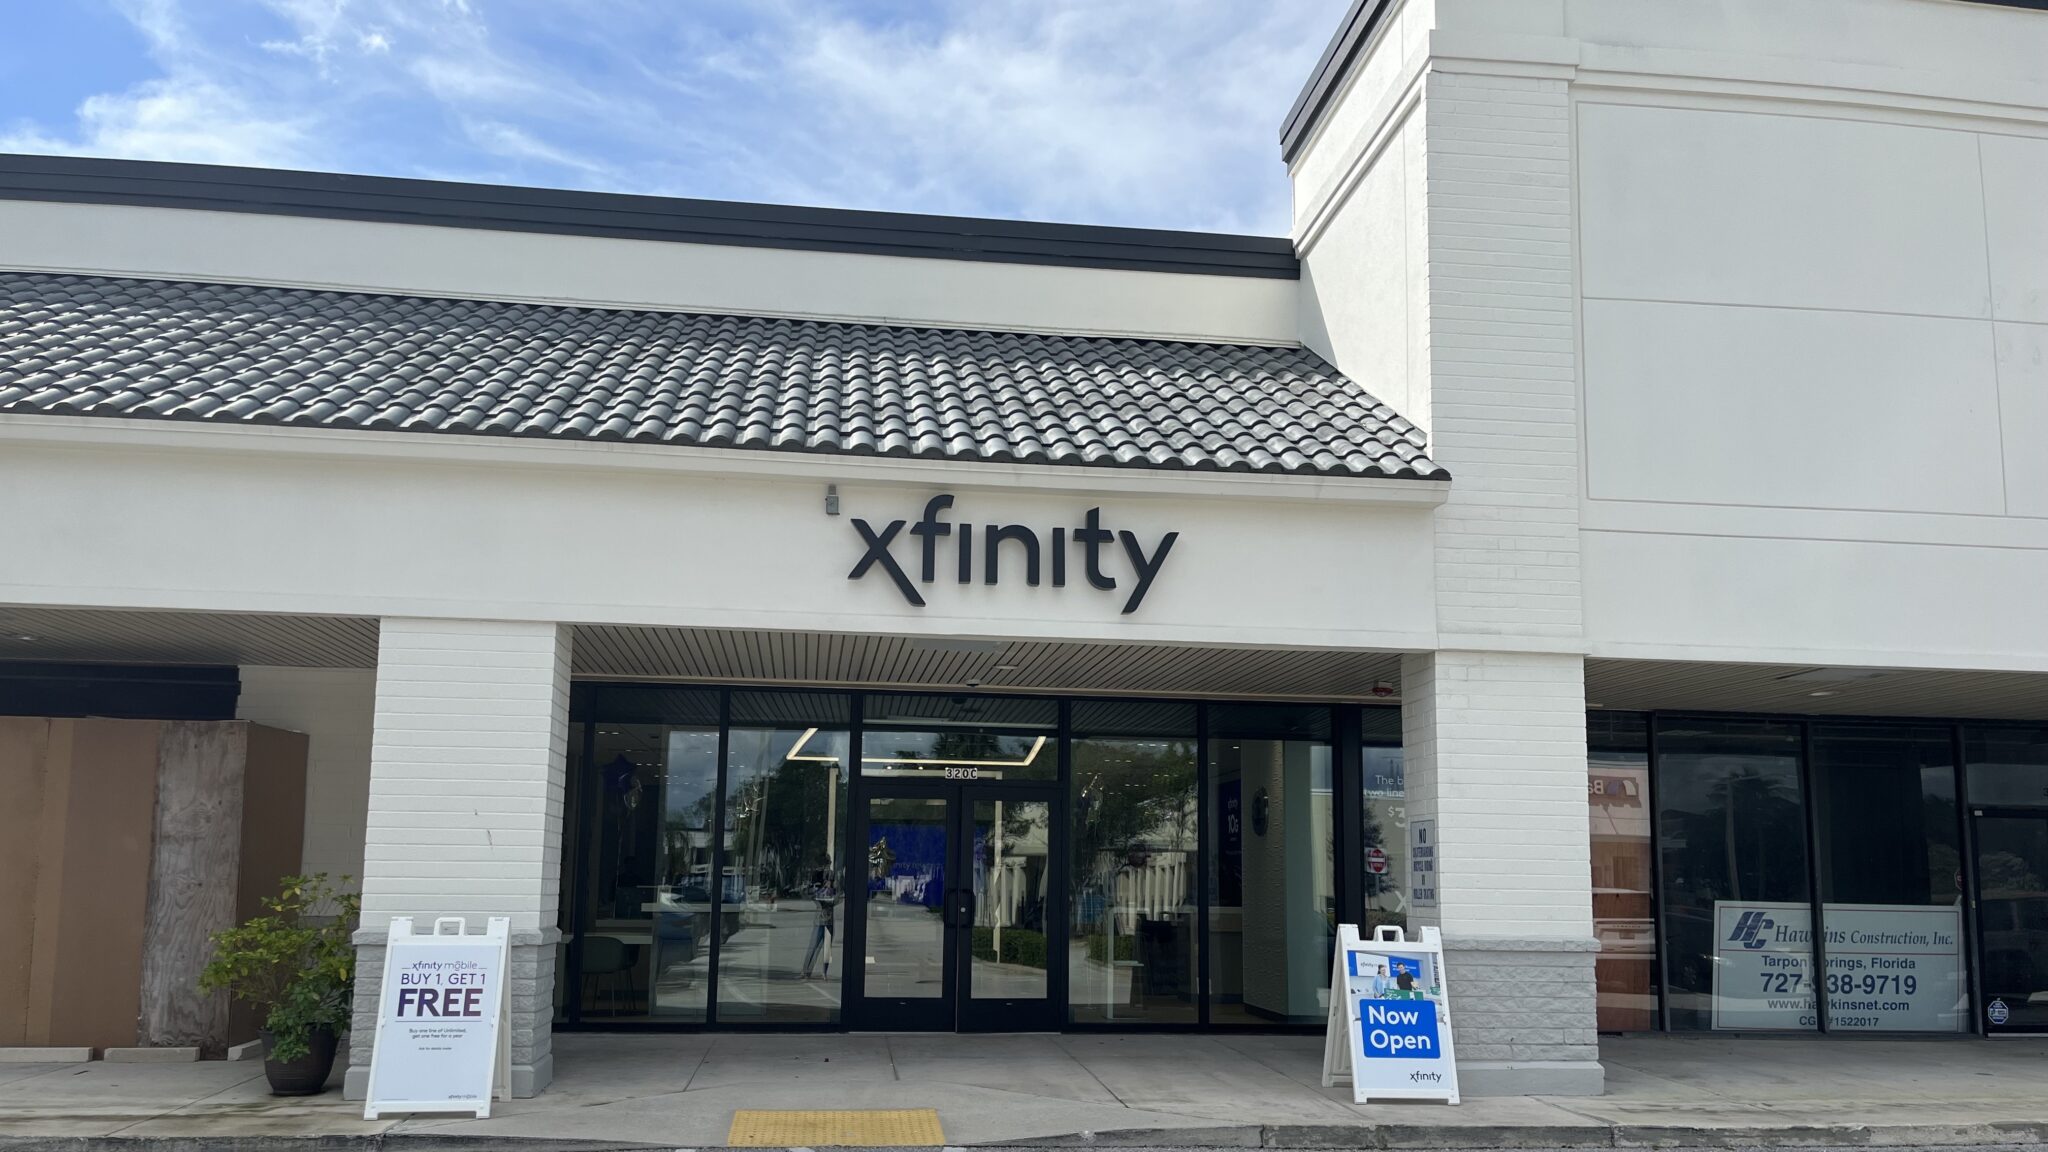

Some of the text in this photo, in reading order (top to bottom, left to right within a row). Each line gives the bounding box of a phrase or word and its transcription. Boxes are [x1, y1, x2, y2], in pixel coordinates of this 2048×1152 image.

[848, 494, 1180, 615] xfinity
[946, 768, 977, 779] 320C
[1376, 775, 1395, 785] The
[1418, 828, 1427, 844] NO
[1775, 925, 1953, 947] Hawins Construction, Inc.
[412, 961, 442, 971] xfinity
[1761, 955, 1808, 969] Tarpon
[1871, 957, 1916, 969] Florida
[401, 973, 486, 986] BUY 1, GET 1
[397, 988, 483, 1017] FREE
[1767, 999, 1910, 1011] www.hakinsnet.com
[1368, 1005, 1419, 1025] Now
[1370, 1029, 1431, 1055] Open
[1410, 1071, 1442, 1083] xfinity
